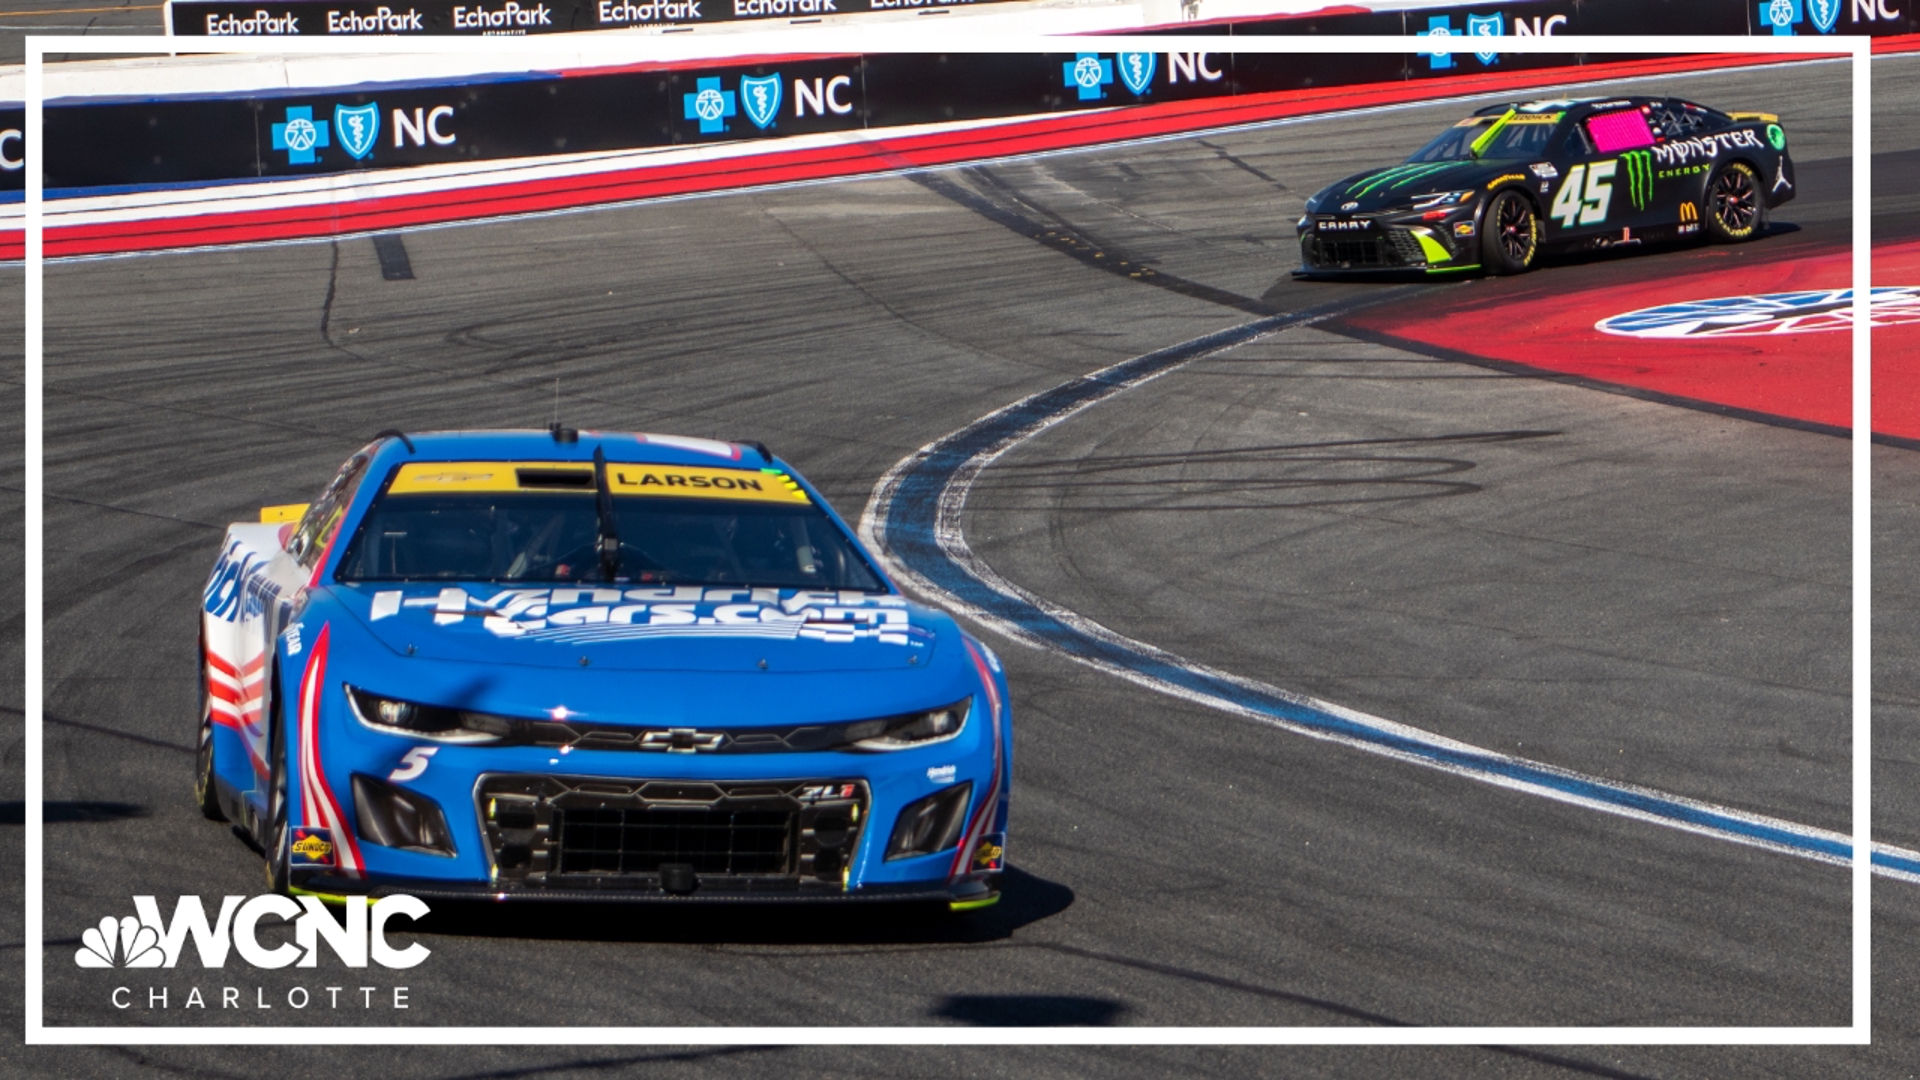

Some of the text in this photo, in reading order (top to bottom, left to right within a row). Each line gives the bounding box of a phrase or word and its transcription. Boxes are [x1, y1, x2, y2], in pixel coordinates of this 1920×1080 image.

[206, 10, 299, 35] EchoPark
[328, 6, 423, 33] EchoPark
[453, 1, 552, 29] EchoPark
[1168, 52, 1223, 83] NC
[795, 74, 852, 117] NC
[393, 105, 456, 148] NC
[1651, 129, 1765, 165] MONSTER
[1658, 163, 1710, 178] ENERGY
[1550, 159, 1617, 229] 45
[1318, 220, 1371, 230] CAMRY
[616, 472, 763, 492] LARSON
[388, 746, 440, 782] 5
[798, 784, 855, 800] ZL1
